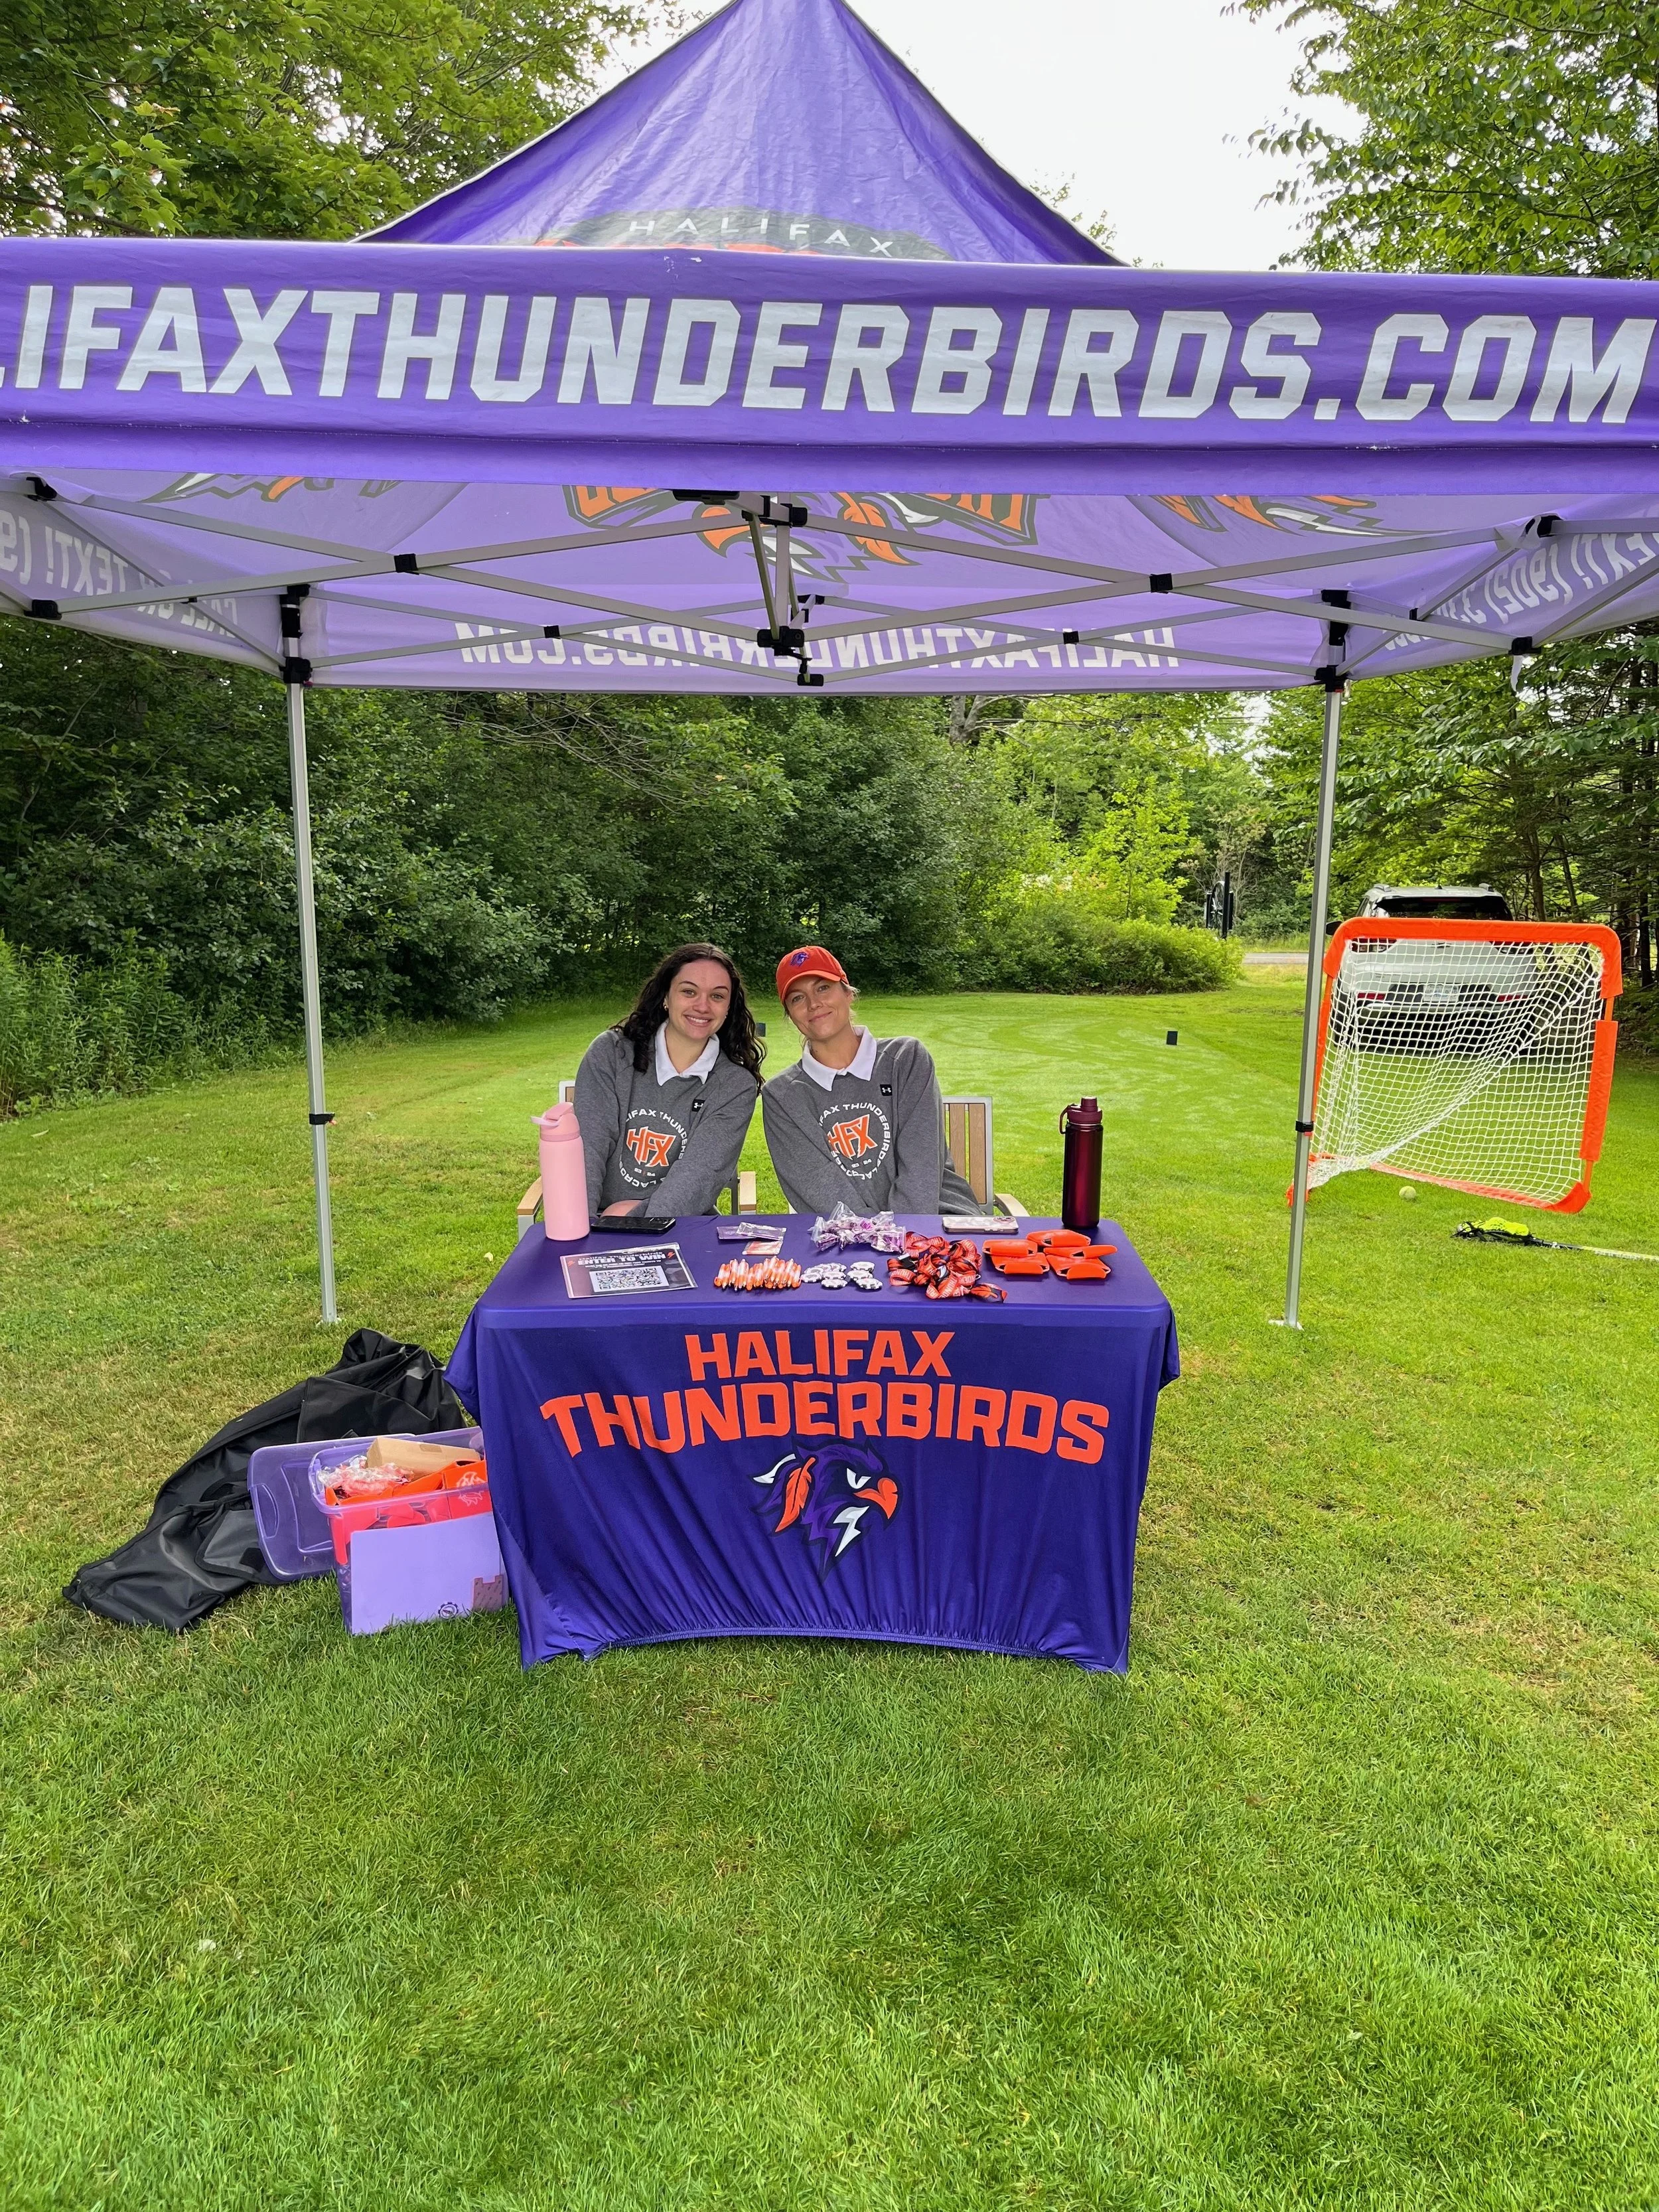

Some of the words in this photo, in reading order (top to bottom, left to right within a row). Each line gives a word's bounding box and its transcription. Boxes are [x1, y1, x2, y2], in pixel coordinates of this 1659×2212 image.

[629, 217, 893, 258] HALIFAX
[0, 285, 1658, 423] IFAXTHUNDERBIRDS.COM
[626, 1126, 677, 1167] HFX
[827, 1114, 878, 1161] HFX
[684, 1329, 956, 1381] HALIFAX
[540, 1380, 1110, 1465] THUNDERBIRDS
